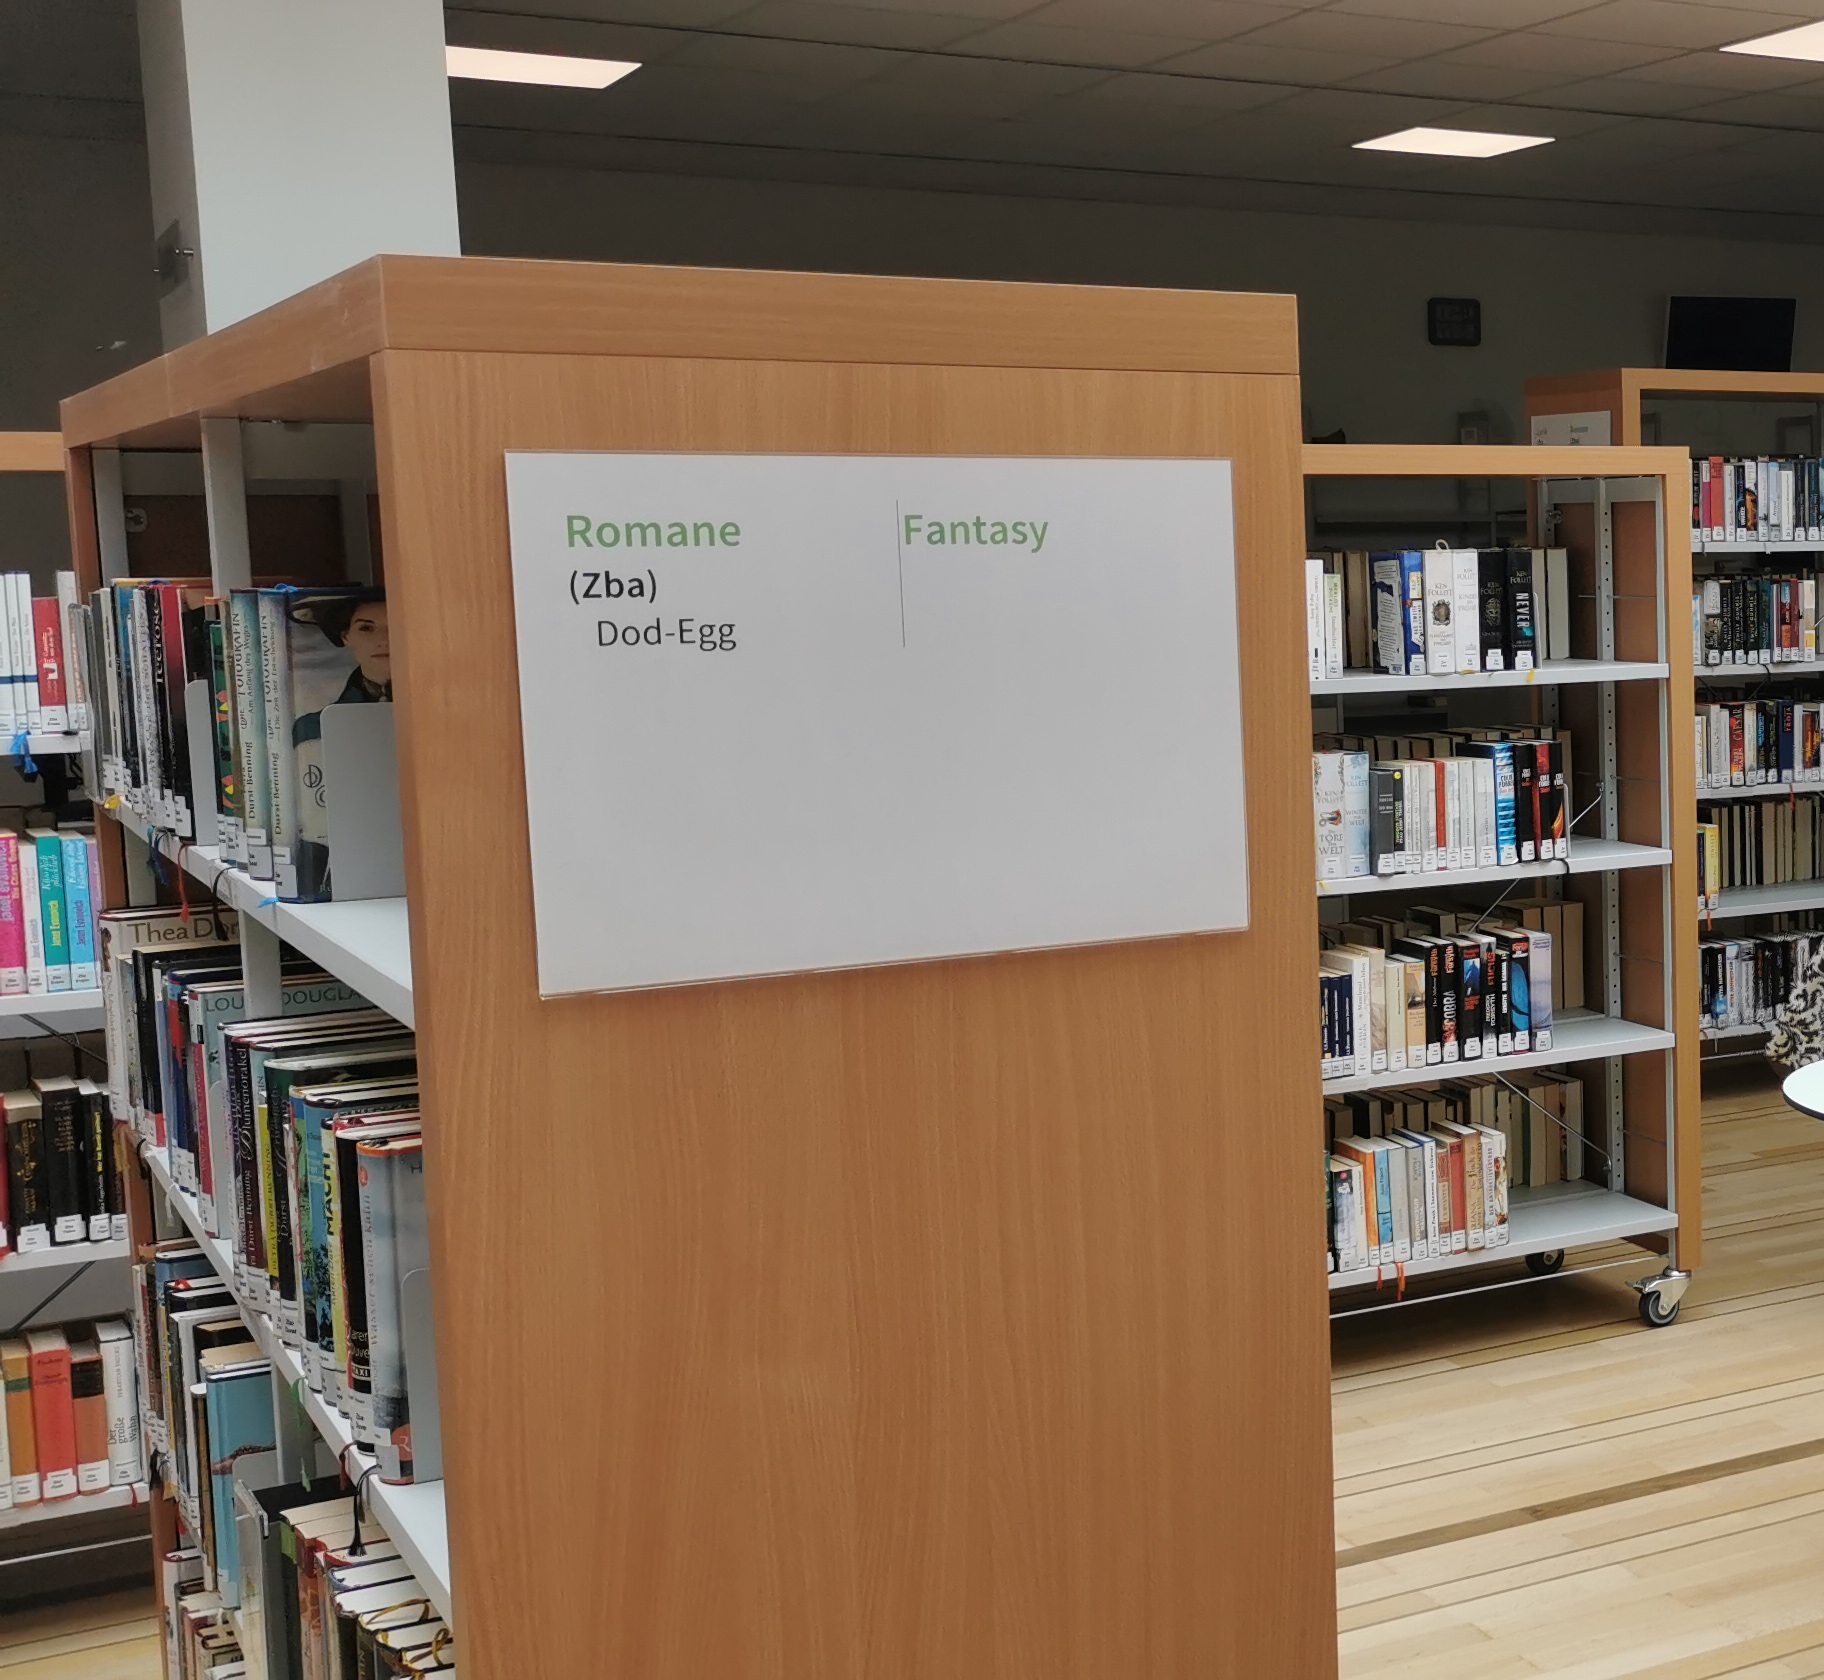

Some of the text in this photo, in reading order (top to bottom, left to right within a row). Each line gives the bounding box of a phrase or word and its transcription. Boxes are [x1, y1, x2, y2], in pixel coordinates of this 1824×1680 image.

[566, 513, 742, 549] Romane
[904, 513, 1050, 553] Fantasy
[569, 569, 658, 604] (Zba)
[1516, 592, 1530, 628] NEVER
[597, 617, 738, 652] Dod-Egg
[1318, 846, 1345, 855] WELT
[126, 921, 190, 944] Thea
[206, 995, 245, 1012] LOU
[322, 1152, 334, 1236] MACHT
